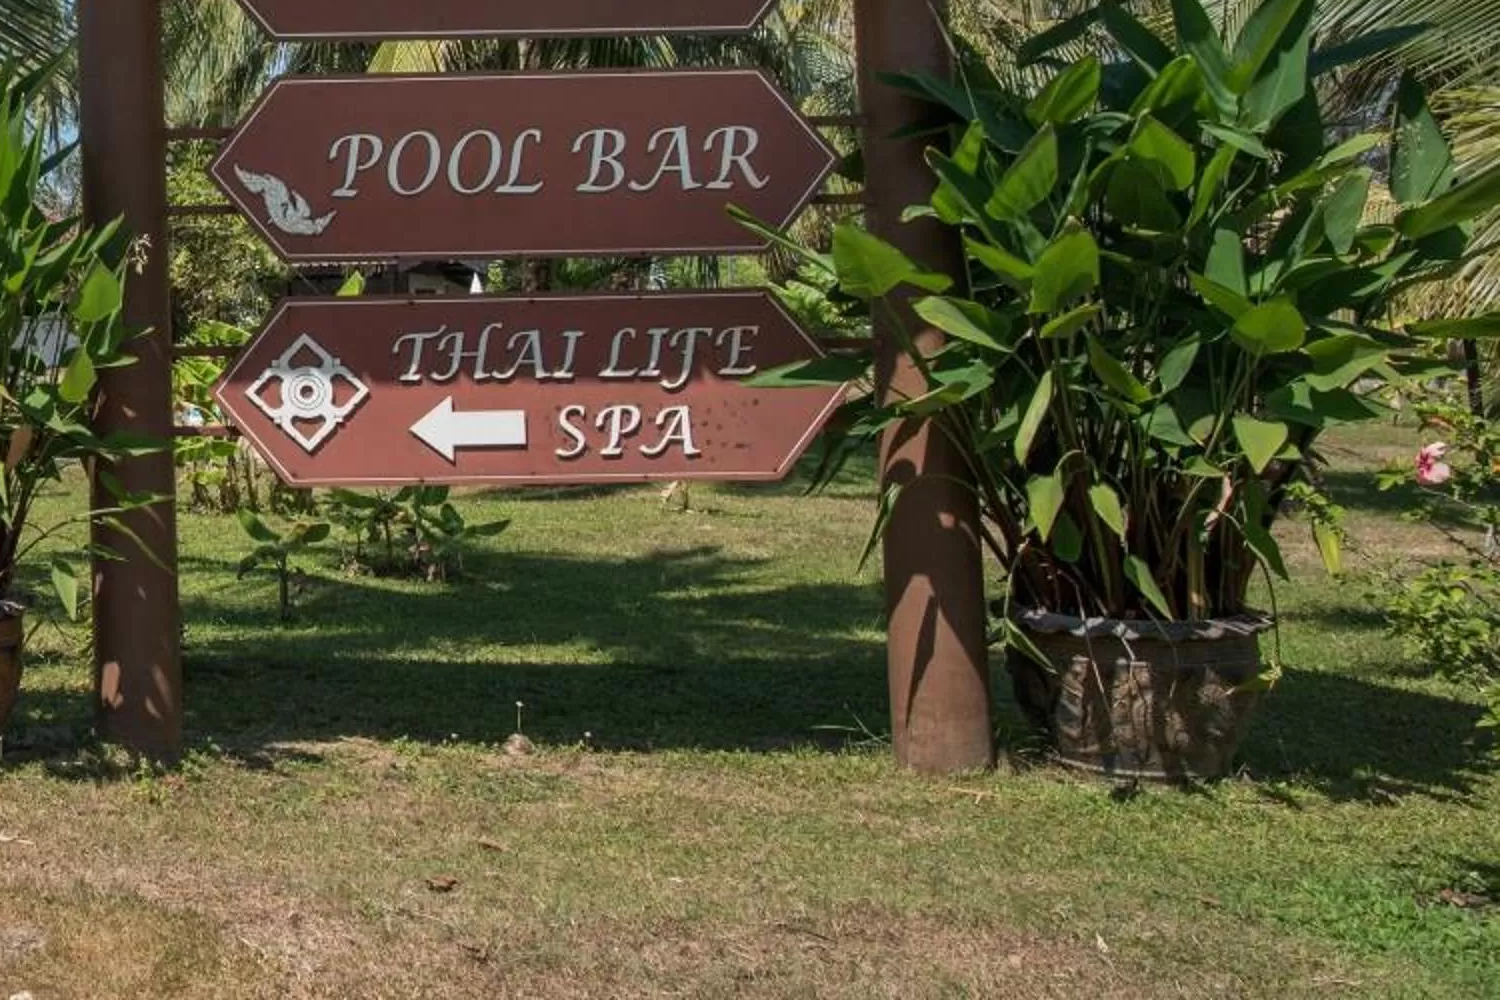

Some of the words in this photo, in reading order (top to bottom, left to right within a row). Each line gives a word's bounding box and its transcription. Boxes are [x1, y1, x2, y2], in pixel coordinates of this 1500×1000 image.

[329, 129, 543, 197] POOL
[572, 125, 769, 192] BAR
[393, 323, 585, 381] THAI
[598, 325, 759, 388] LIFE
[555, 405, 701, 457] SPA
